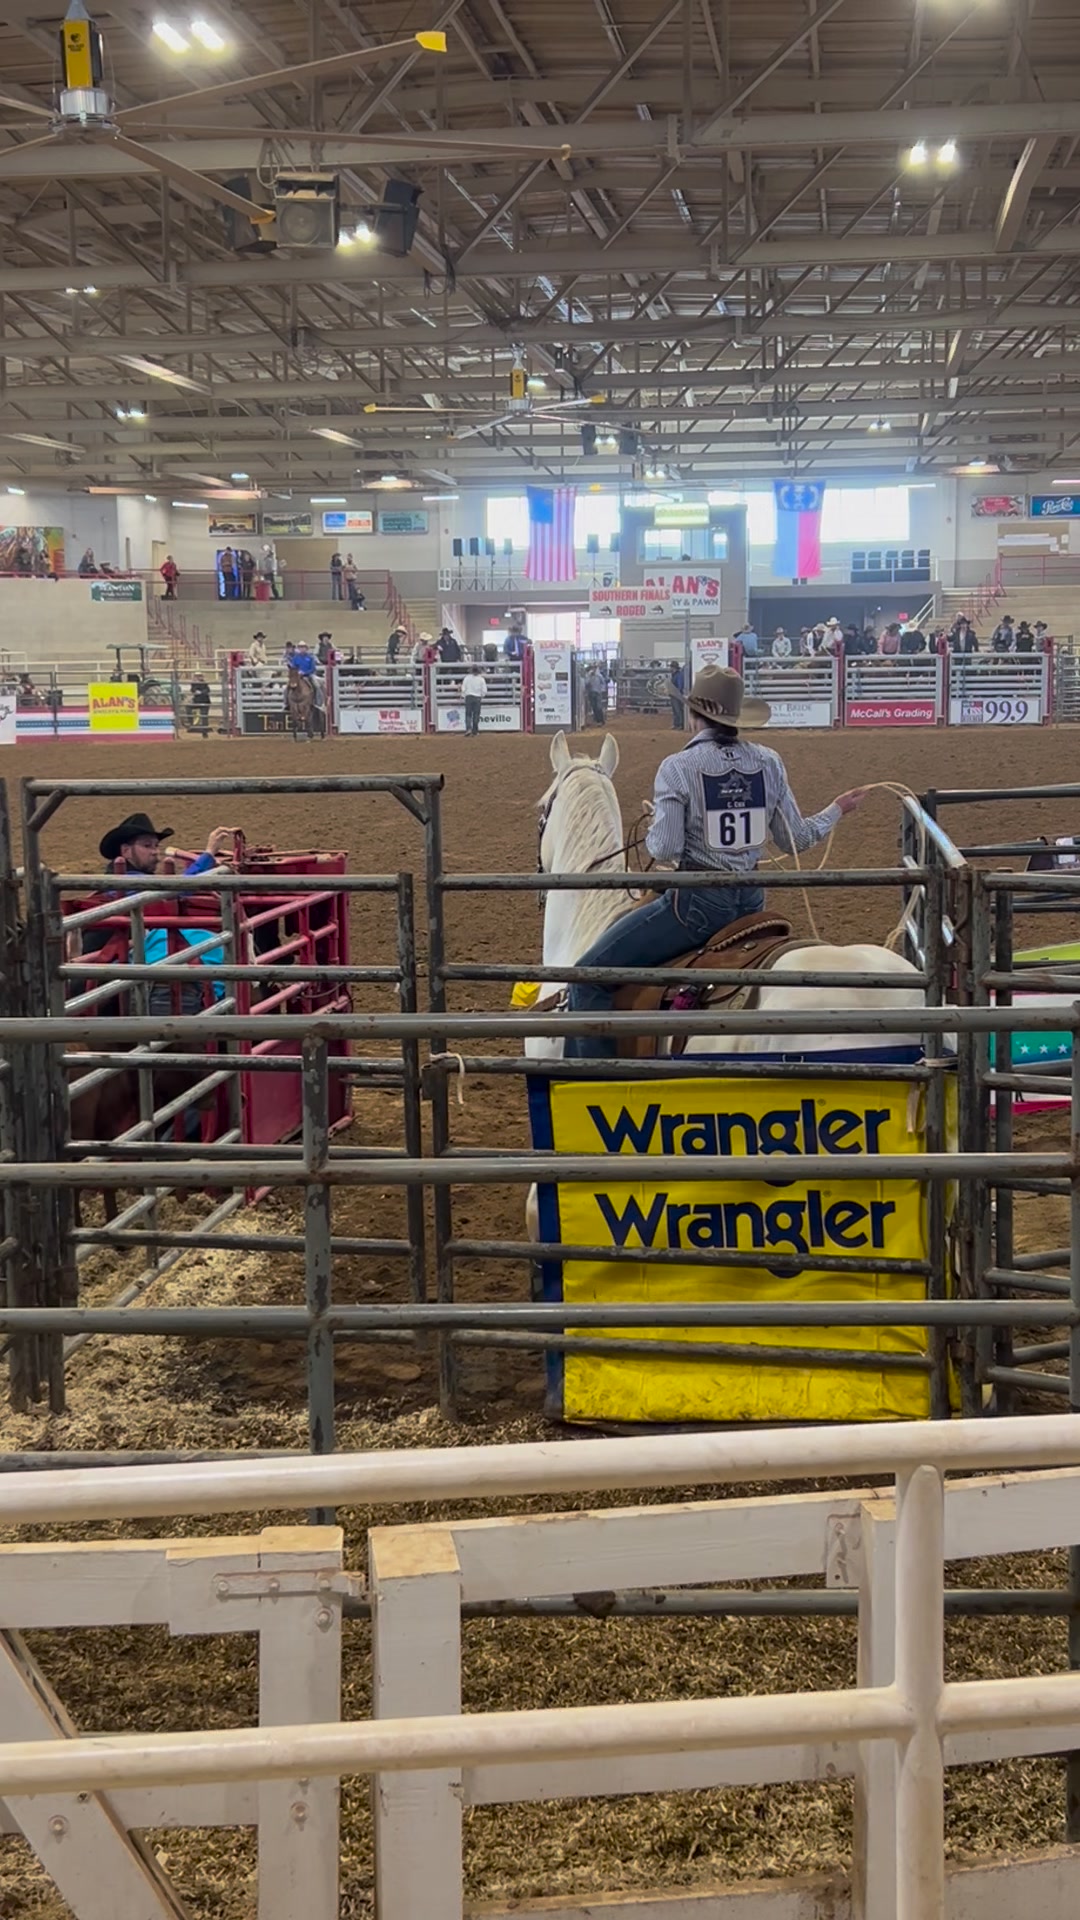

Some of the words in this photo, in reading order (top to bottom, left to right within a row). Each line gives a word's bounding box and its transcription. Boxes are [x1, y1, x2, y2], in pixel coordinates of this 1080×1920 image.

[592, 589, 638, 602] SOUTHERN
[640, 589, 670, 601] FINALS
[683, 598, 690, 606] &
[692, 598, 719, 606] PAWN
[616, 605, 646, 617] RODEO
[696, 640, 723, 648] ALAN'S
[92, 696, 136, 709] ALAN'S
[379, 710, 400, 719] WCB
[850, 708, 891, 718] McCall's
[893, 708, 933, 719] Grading
[985, 700, 1029, 722] 99.9
[719, 811, 752, 846] 61
[587, 1099, 890, 1186] Wrangler
[595, 1190, 895, 1278] Wrangler
